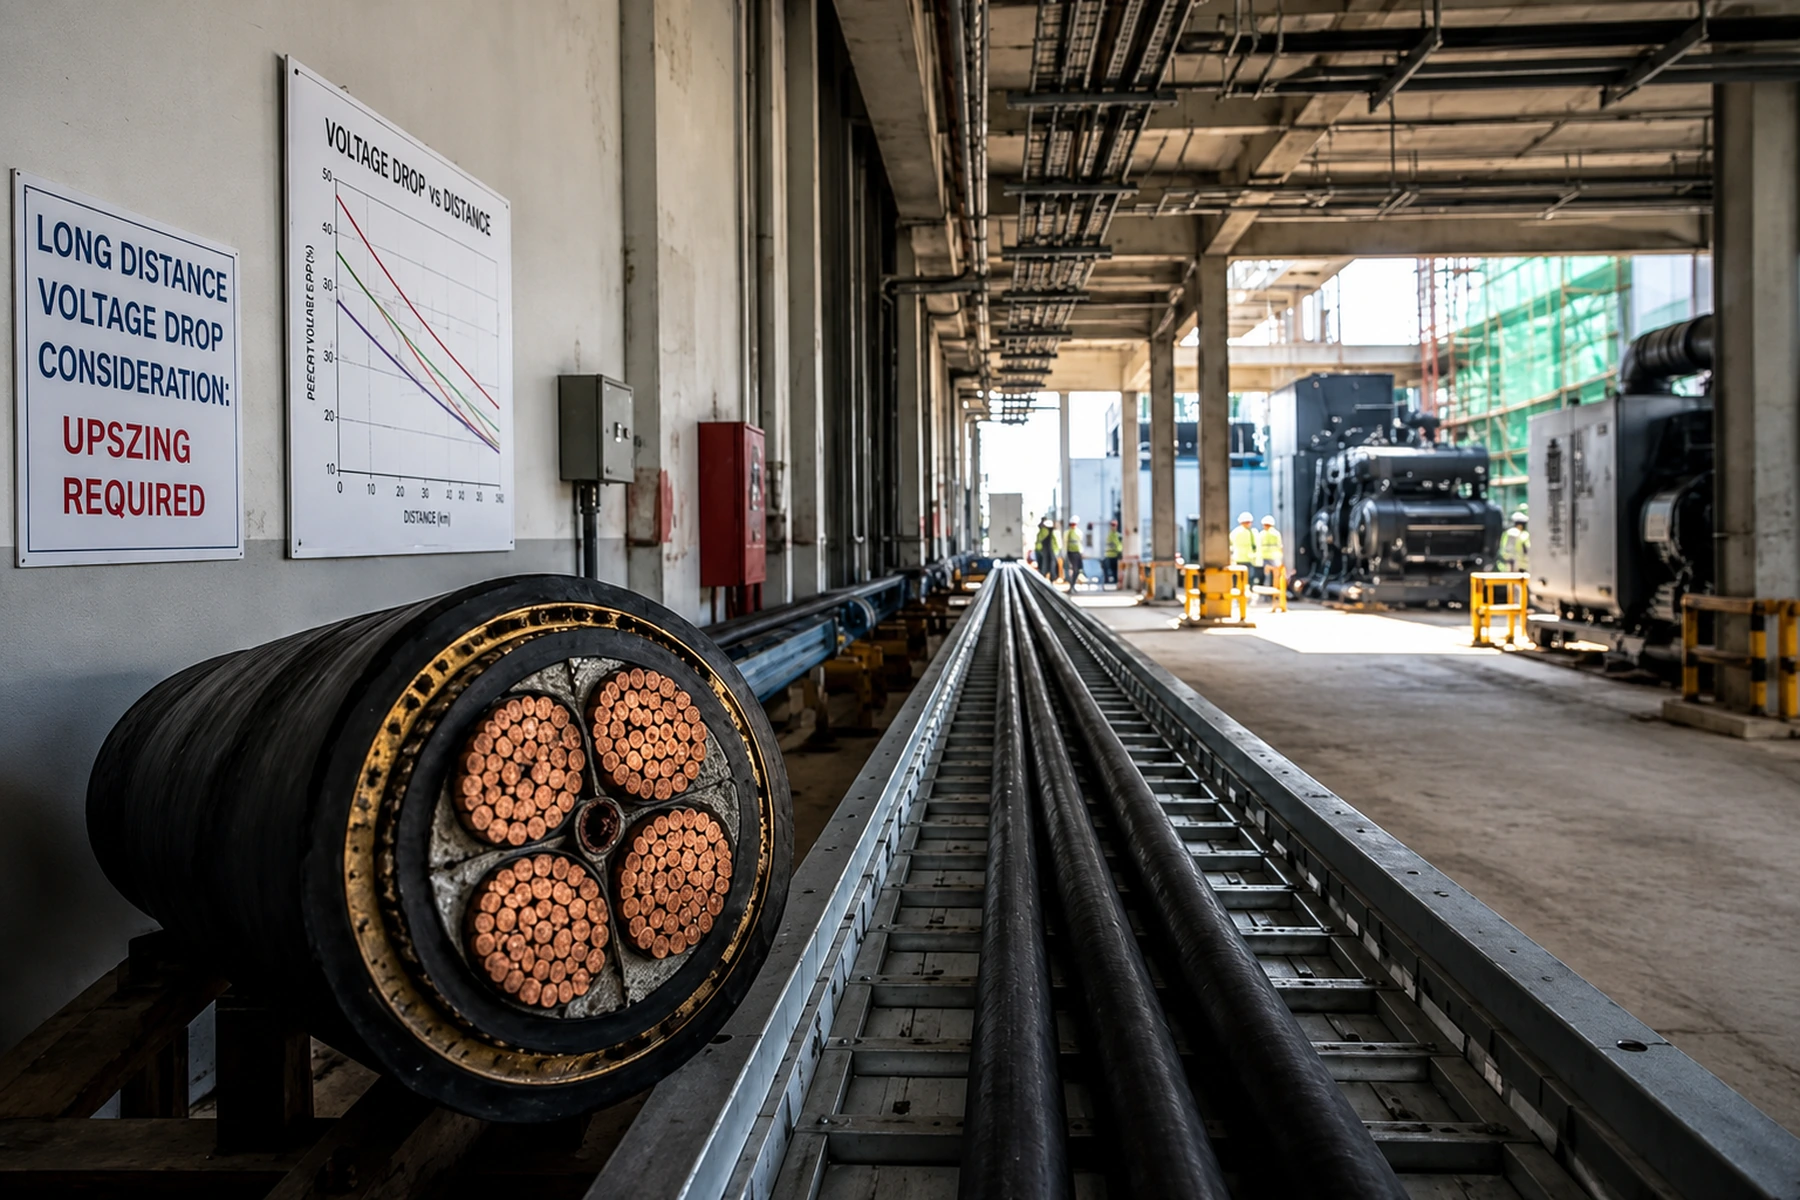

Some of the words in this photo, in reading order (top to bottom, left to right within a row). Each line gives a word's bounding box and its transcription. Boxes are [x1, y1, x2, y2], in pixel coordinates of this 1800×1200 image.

[322, 167, 333, 182] 50
[325, 117, 389, 179] VOLTAGE
[393, 158, 426, 198] DROP
[443, 188, 492, 237] DISTANCE
[37, 214, 112, 270] LONG
[120, 242, 228, 303] DISTANCE
[37, 277, 157, 340] VOLTAGE
[164, 309, 224, 352] DROP
[323, 350, 334, 363] 30
[38, 341, 230, 407] CONSIDERATION:
[324, 409, 335, 421] 20
[63, 415, 191, 463] UPSZING
[326, 463, 336, 475] 10
[63, 477, 206, 519] REQUIRED
[336, 481, 343, 494] 0
[367, 483, 376, 495] 10
[396, 485, 405, 498] 20
[403, 509, 437, 525] DISTANCE
